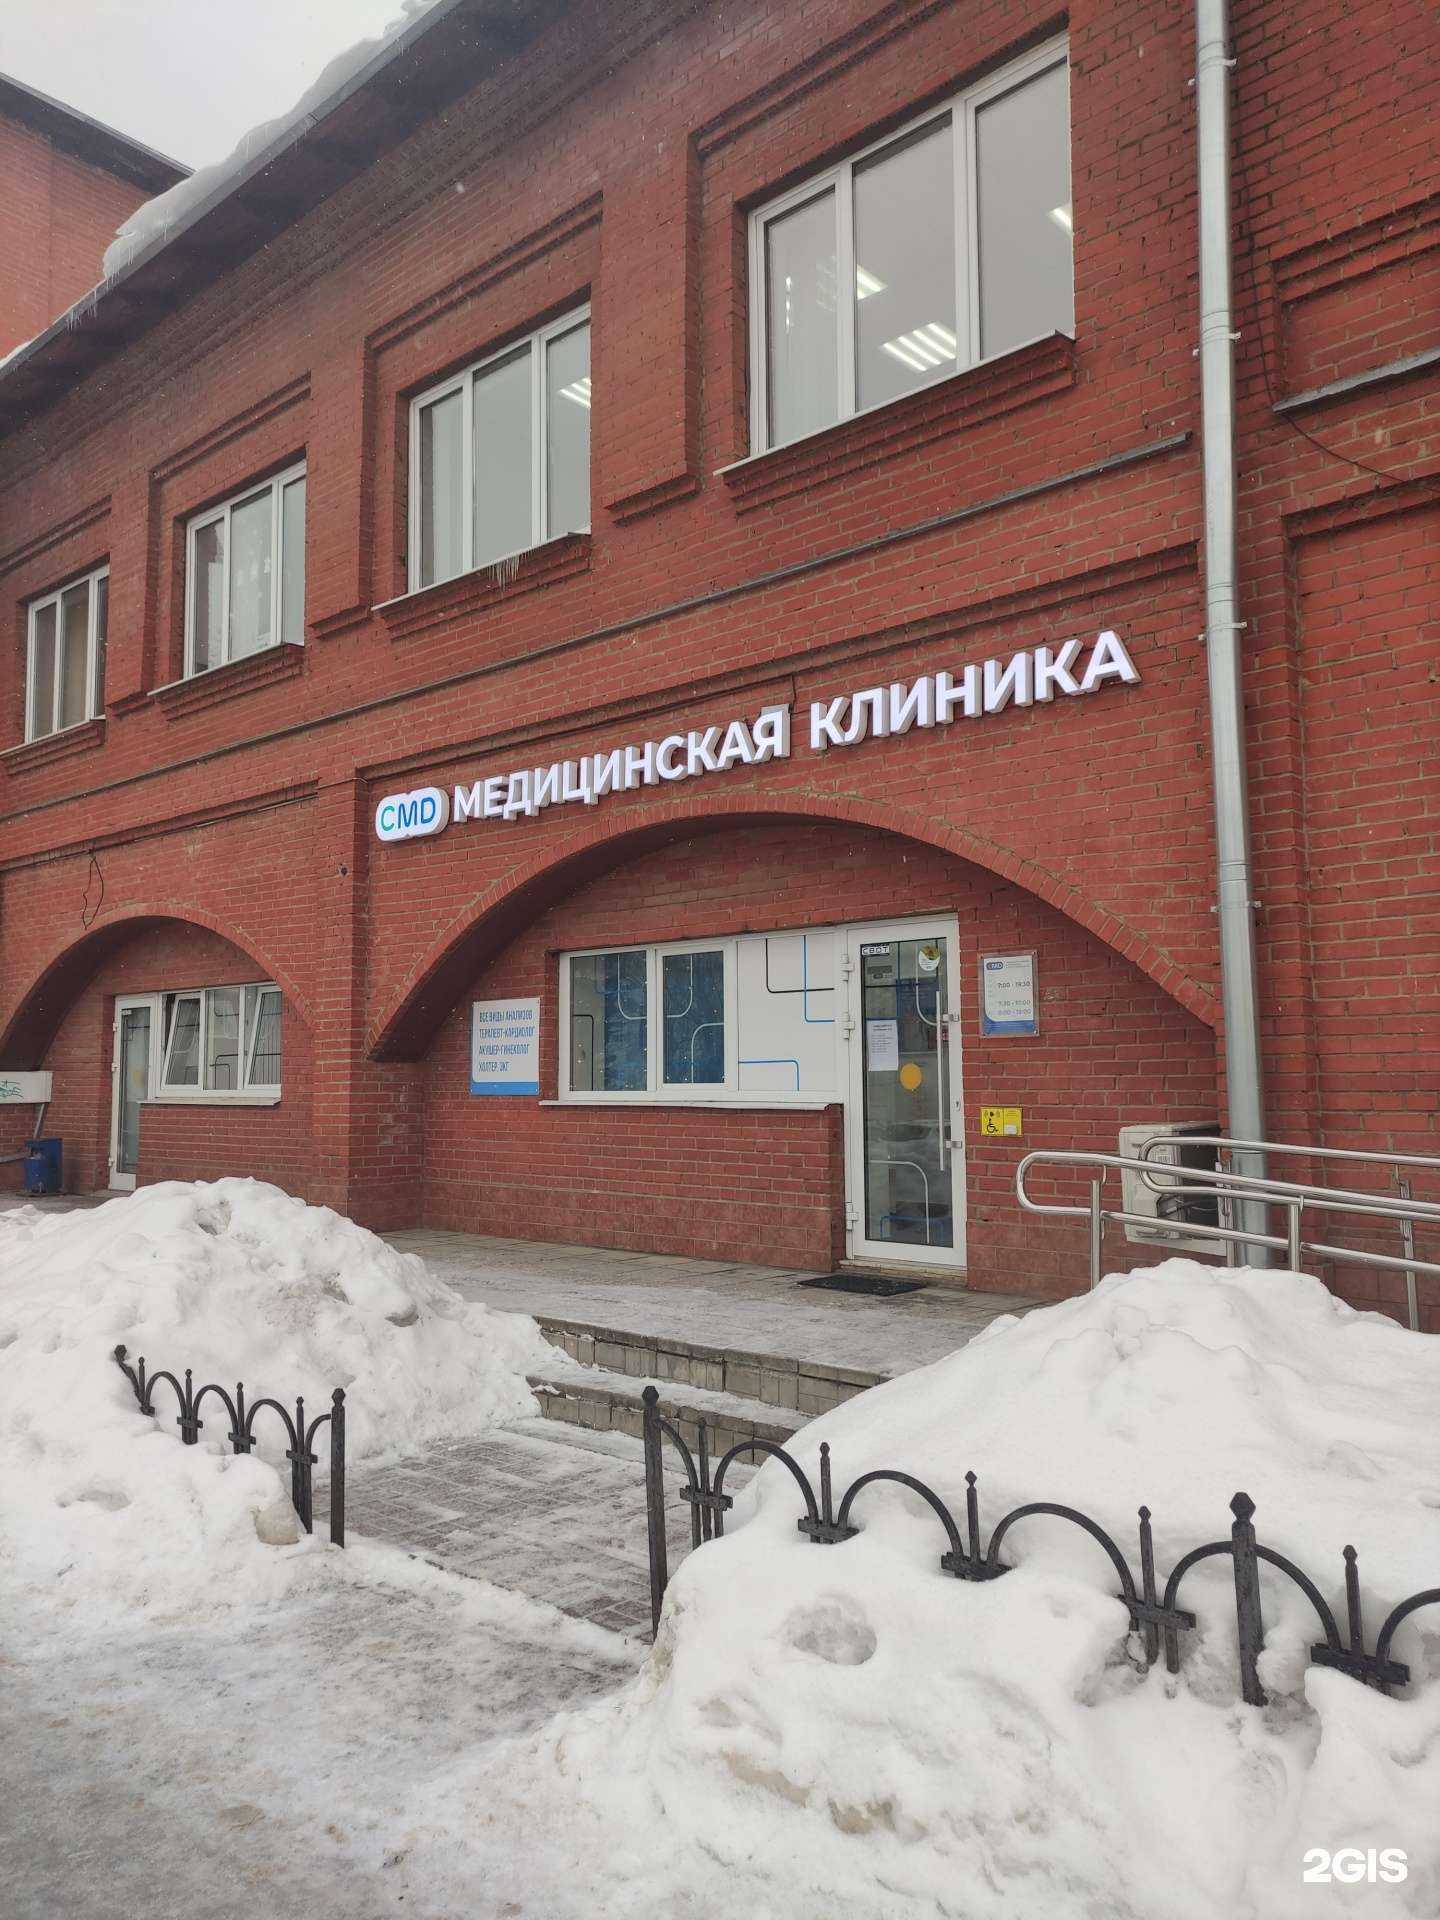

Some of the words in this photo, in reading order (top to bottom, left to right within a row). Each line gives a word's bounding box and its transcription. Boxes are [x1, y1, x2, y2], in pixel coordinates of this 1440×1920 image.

[453, 708, 790, 823] МЕДИЦИНСКАЯ
[810, 630, 1140, 750] КЛИНИКА
[380, 797, 438, 834] CMD
[479, 1012, 489, 1022] ВСЕ
[489, 1011, 504, 1022] ВИДЫ
[505, 1009, 533, 1020] АНАЛИЗОВ
[479, 1026, 535, 1038] ТЕРАПЕВТ-КАРДИОЛОГ
[479, 1044, 529, 1055] АКУШЕР-ГИНЕКОЛОГ
